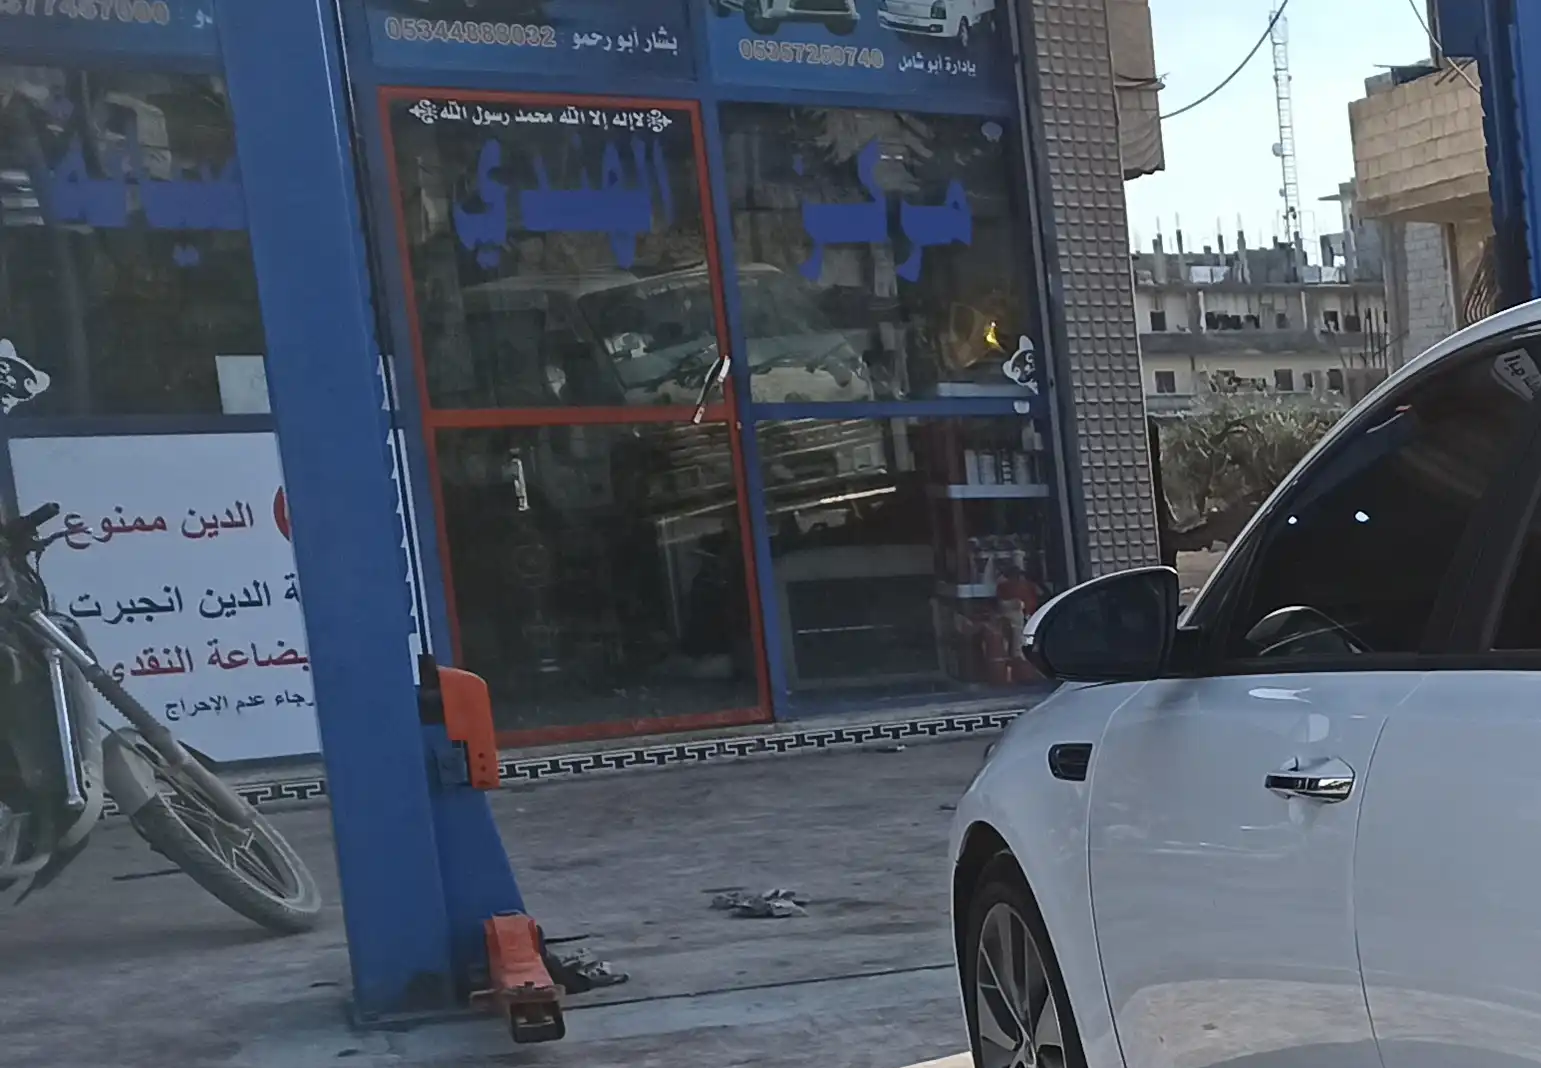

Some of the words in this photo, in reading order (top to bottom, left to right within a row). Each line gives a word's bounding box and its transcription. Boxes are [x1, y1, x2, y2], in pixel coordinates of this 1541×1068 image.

[472, 106, 509, 128] رسول
[515, 110, 553, 124] محمد
[64, 505, 167, 549] ممنوع
[181, 500, 254, 539] الدين
[199, 579, 271, 618] الدين
[235, 694, 265, 714] عدم
